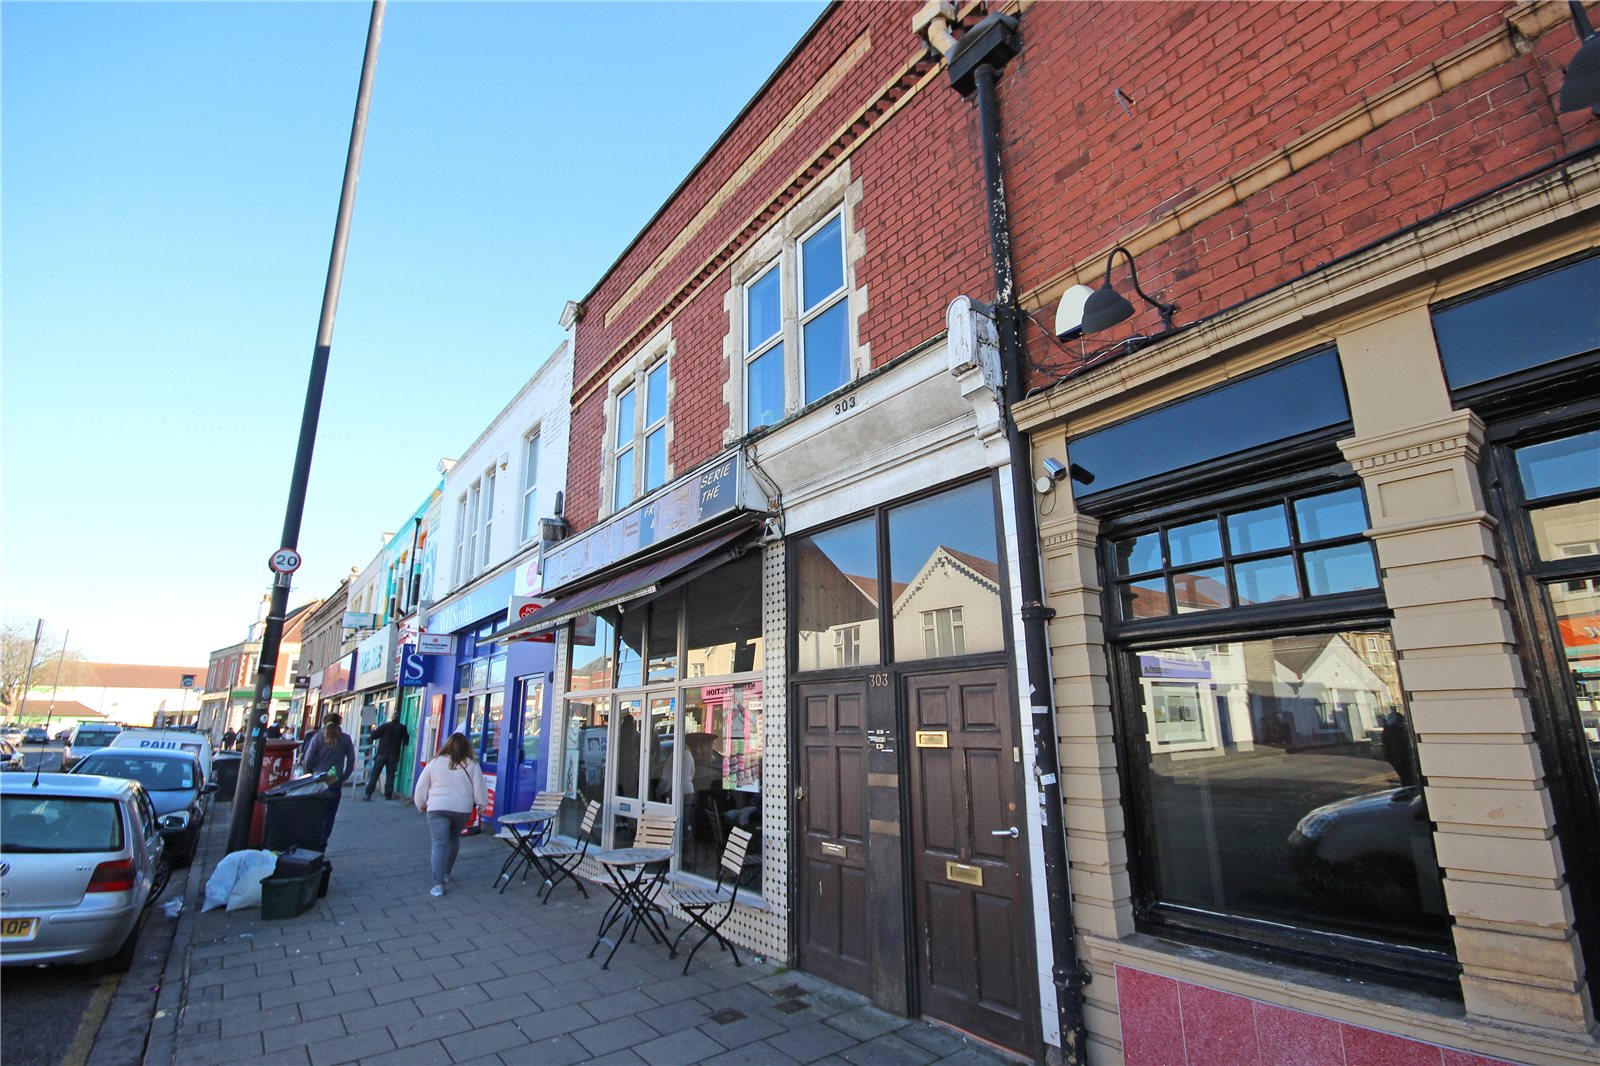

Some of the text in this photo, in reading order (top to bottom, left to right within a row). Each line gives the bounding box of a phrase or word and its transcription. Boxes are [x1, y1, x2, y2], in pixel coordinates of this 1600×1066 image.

[834, 396, 857, 416] 303
[276, 554, 298, 567] 20
[439, 597, 474, 634] WHSmith
[869, 674, 889, 687] 303
